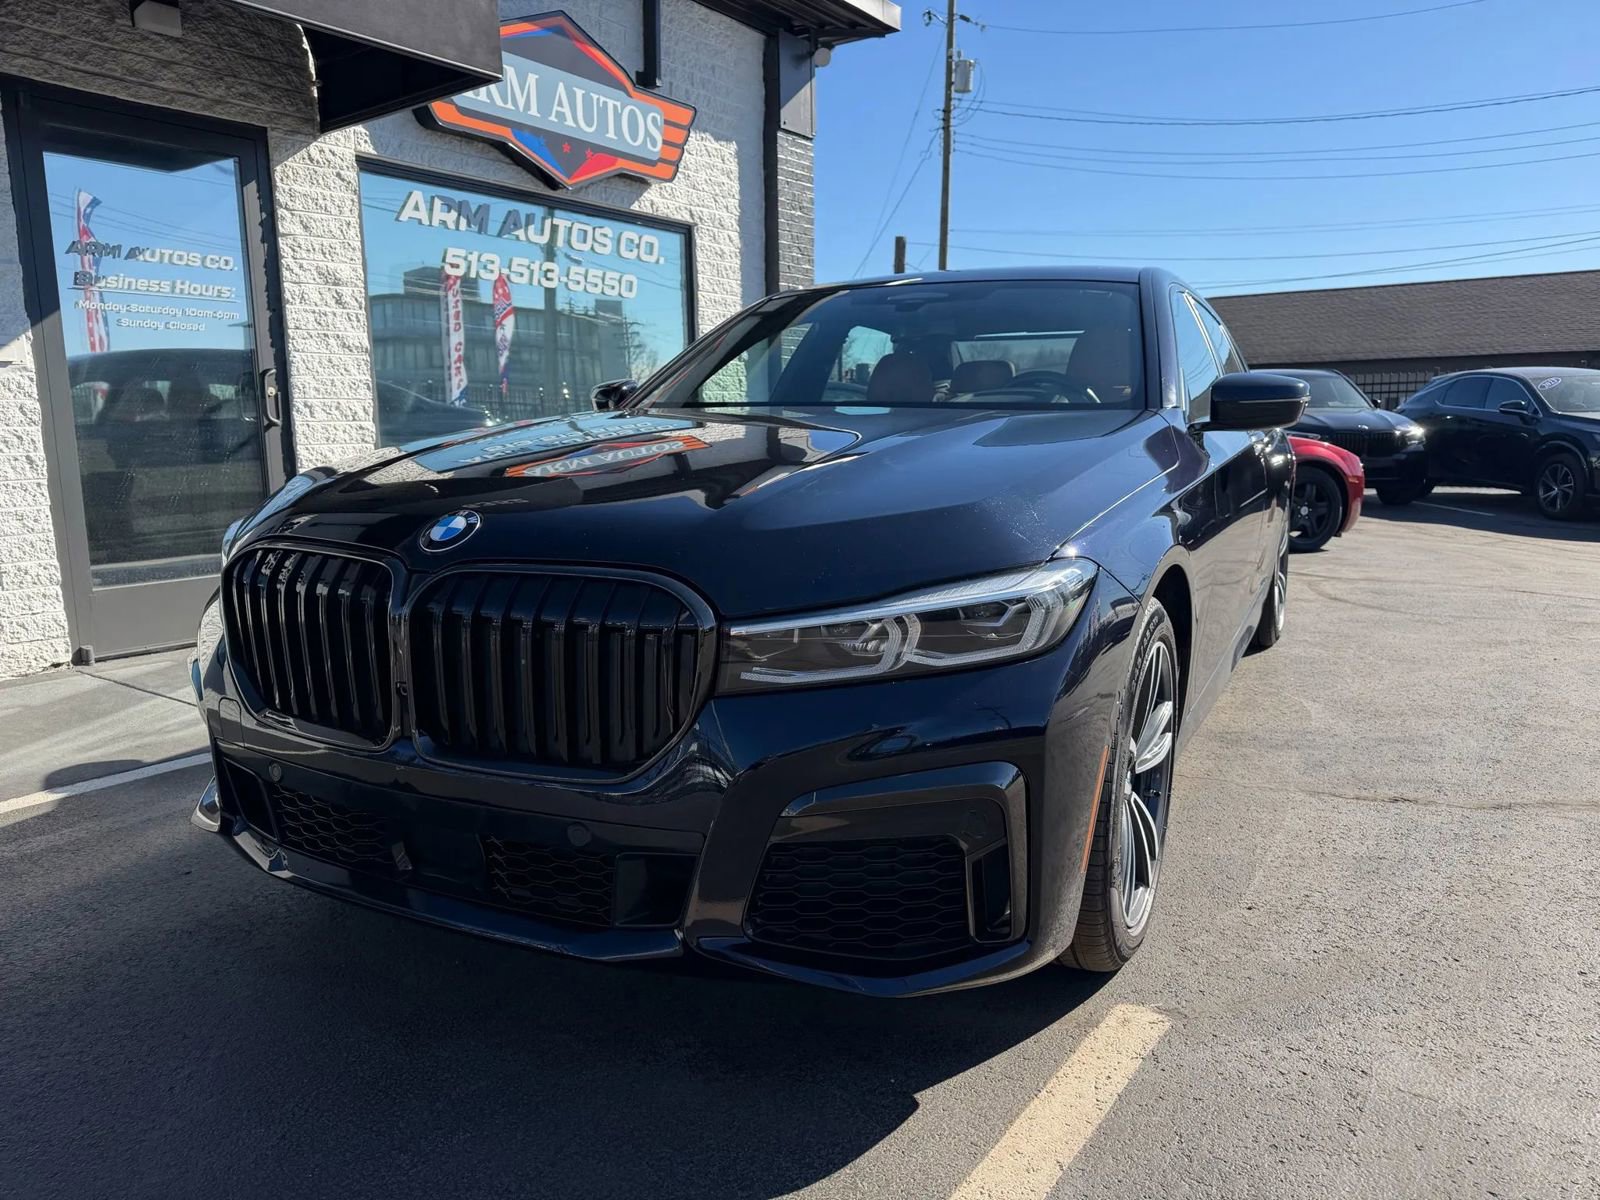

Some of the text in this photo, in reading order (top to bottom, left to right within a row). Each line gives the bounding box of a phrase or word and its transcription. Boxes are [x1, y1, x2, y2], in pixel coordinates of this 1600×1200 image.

[548, 82, 663, 153] AUTOS
[397, 190, 665, 265] ARM AUTOS CO.
[124, 246, 201, 268] AUTOS
[204, 254, 238, 271] CO.
[443, 247, 638, 299] 513-513-5550
[73, 271, 236, 299] Business Hours:
[119, 317, 206, 332] Sunday Closed
